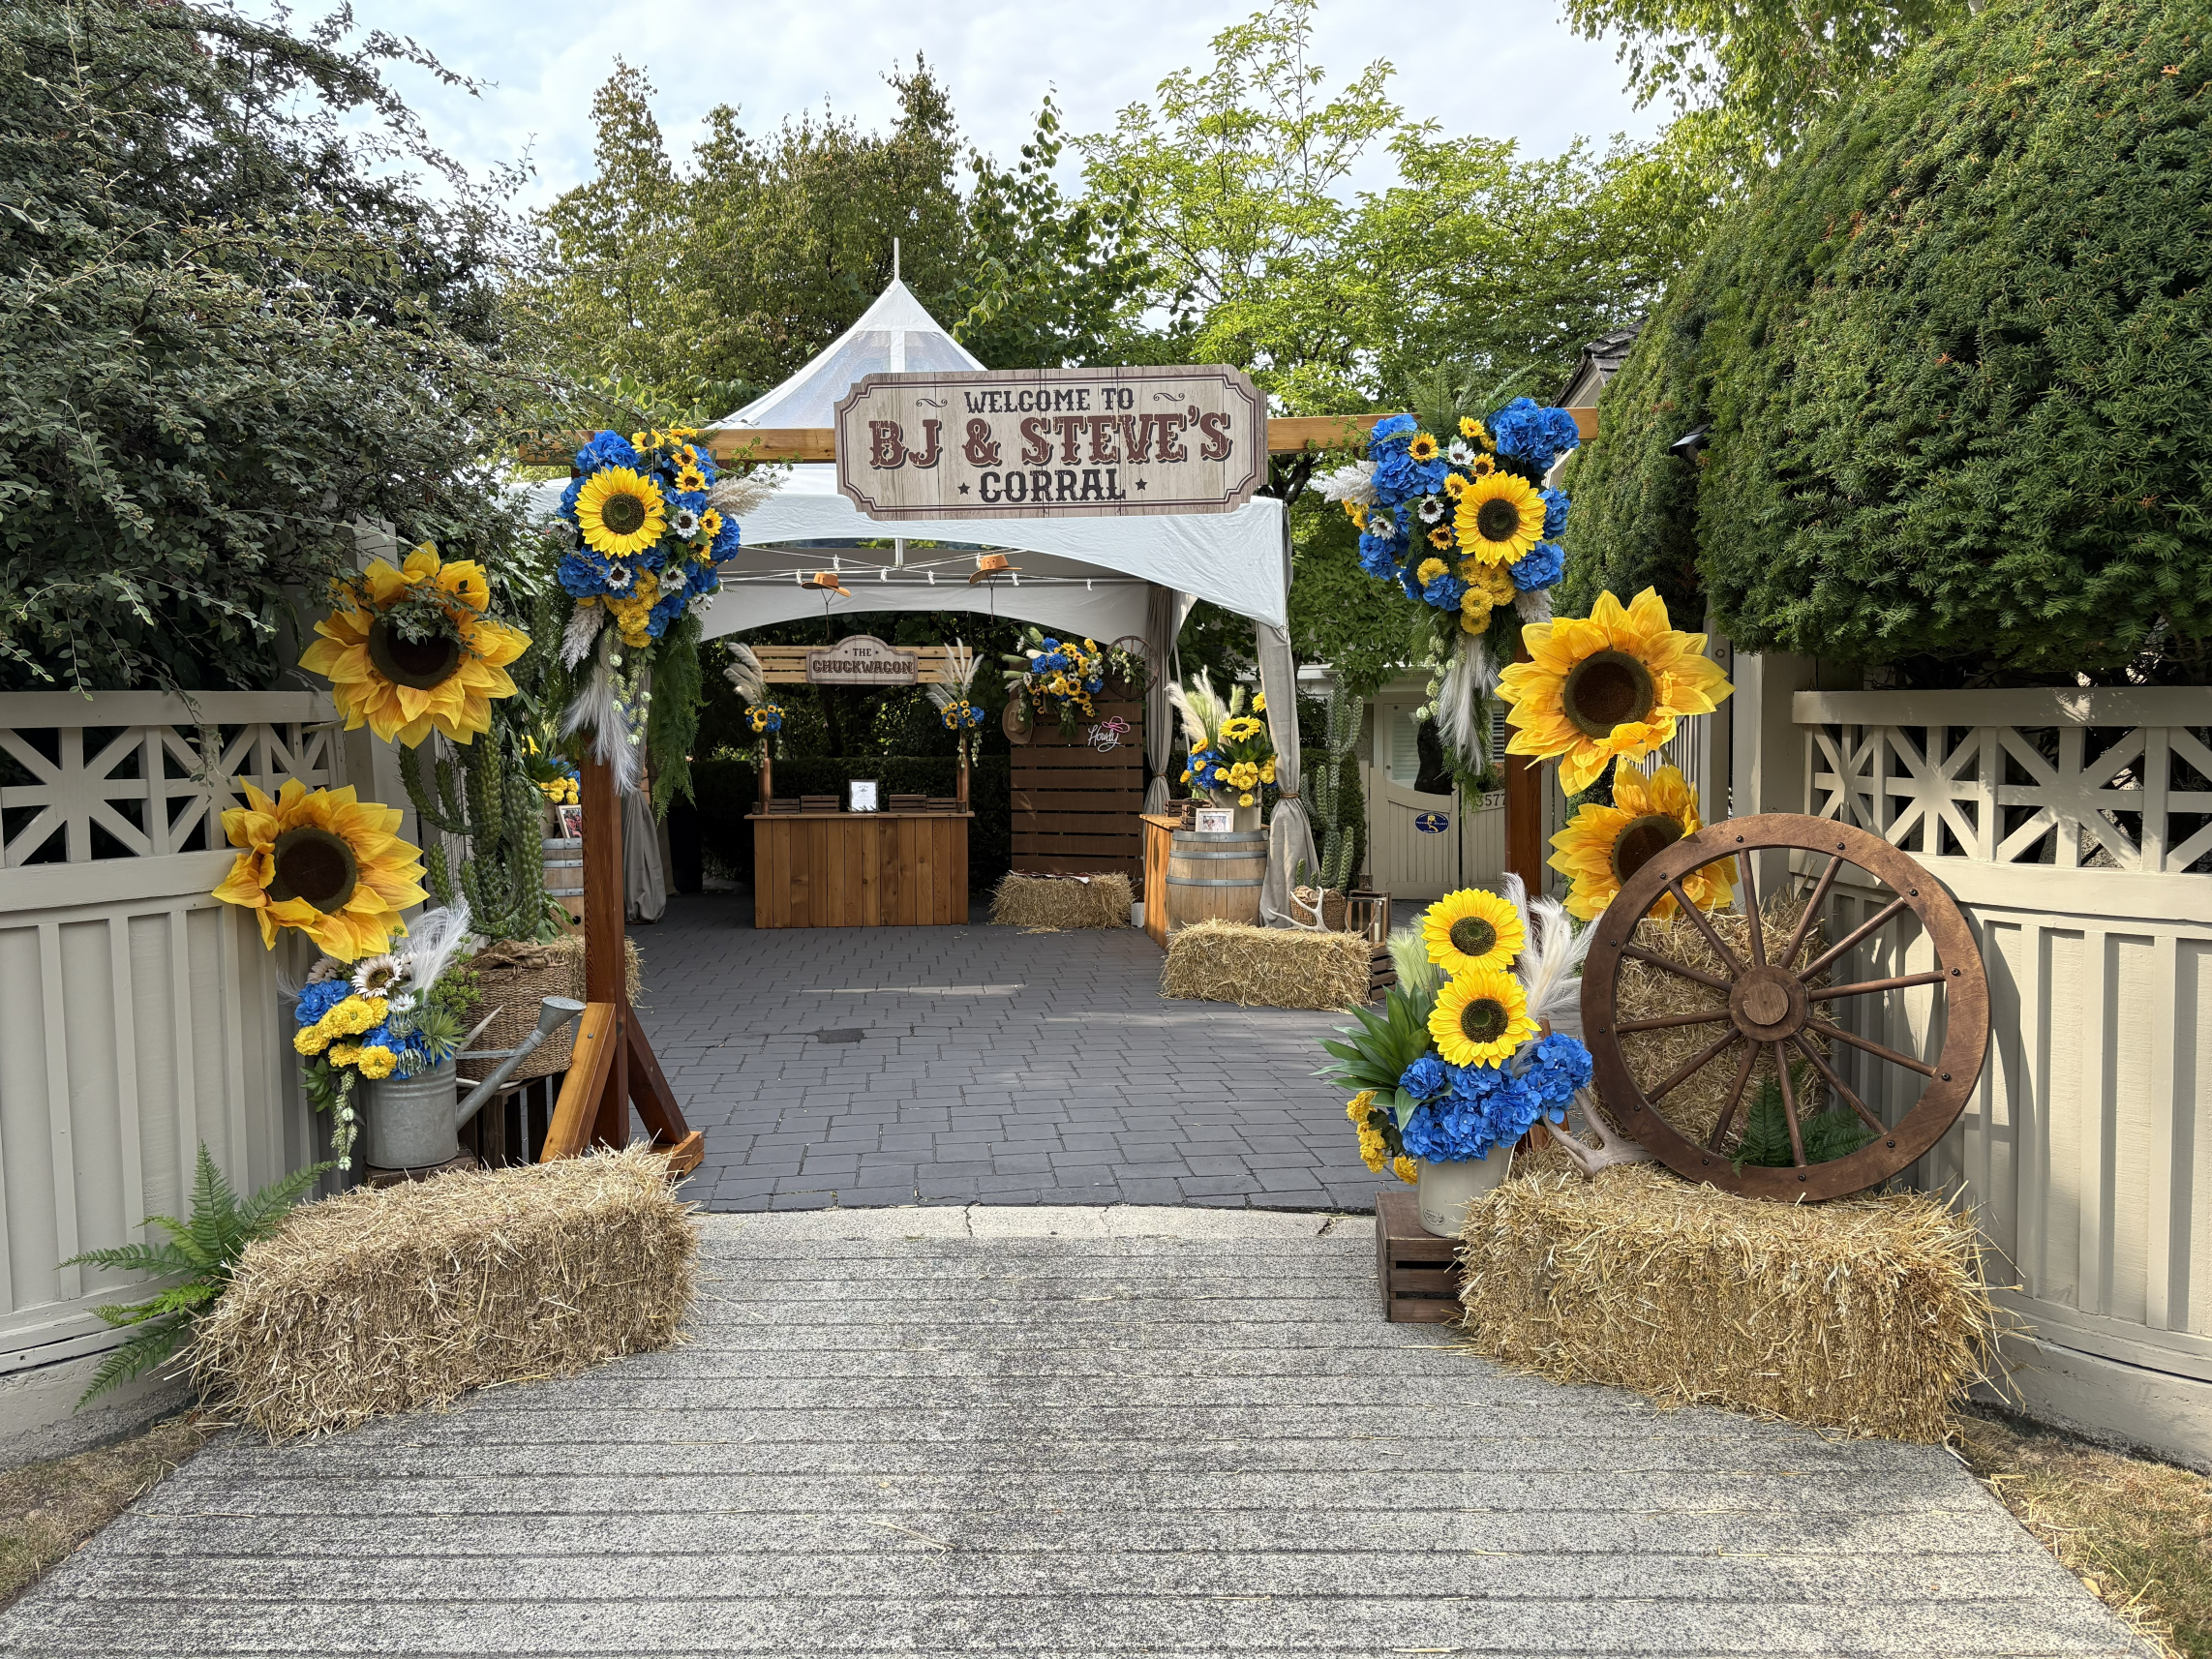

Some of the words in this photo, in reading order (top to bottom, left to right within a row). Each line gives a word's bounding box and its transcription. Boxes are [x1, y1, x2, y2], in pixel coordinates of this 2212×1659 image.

[964, 388, 1090, 413] WELCOME
[1102, 387, 1135, 410] TO
[868, 418, 943, 469] BJ
[961, 417, 1003, 468] &
[1019, 405, 1233, 466] STEVE'S
[979, 468, 1126, 502] CORRAL
[812, 660, 913, 674] CHUCKWAGON
[1087, 724, 1125, 753] Howdy
